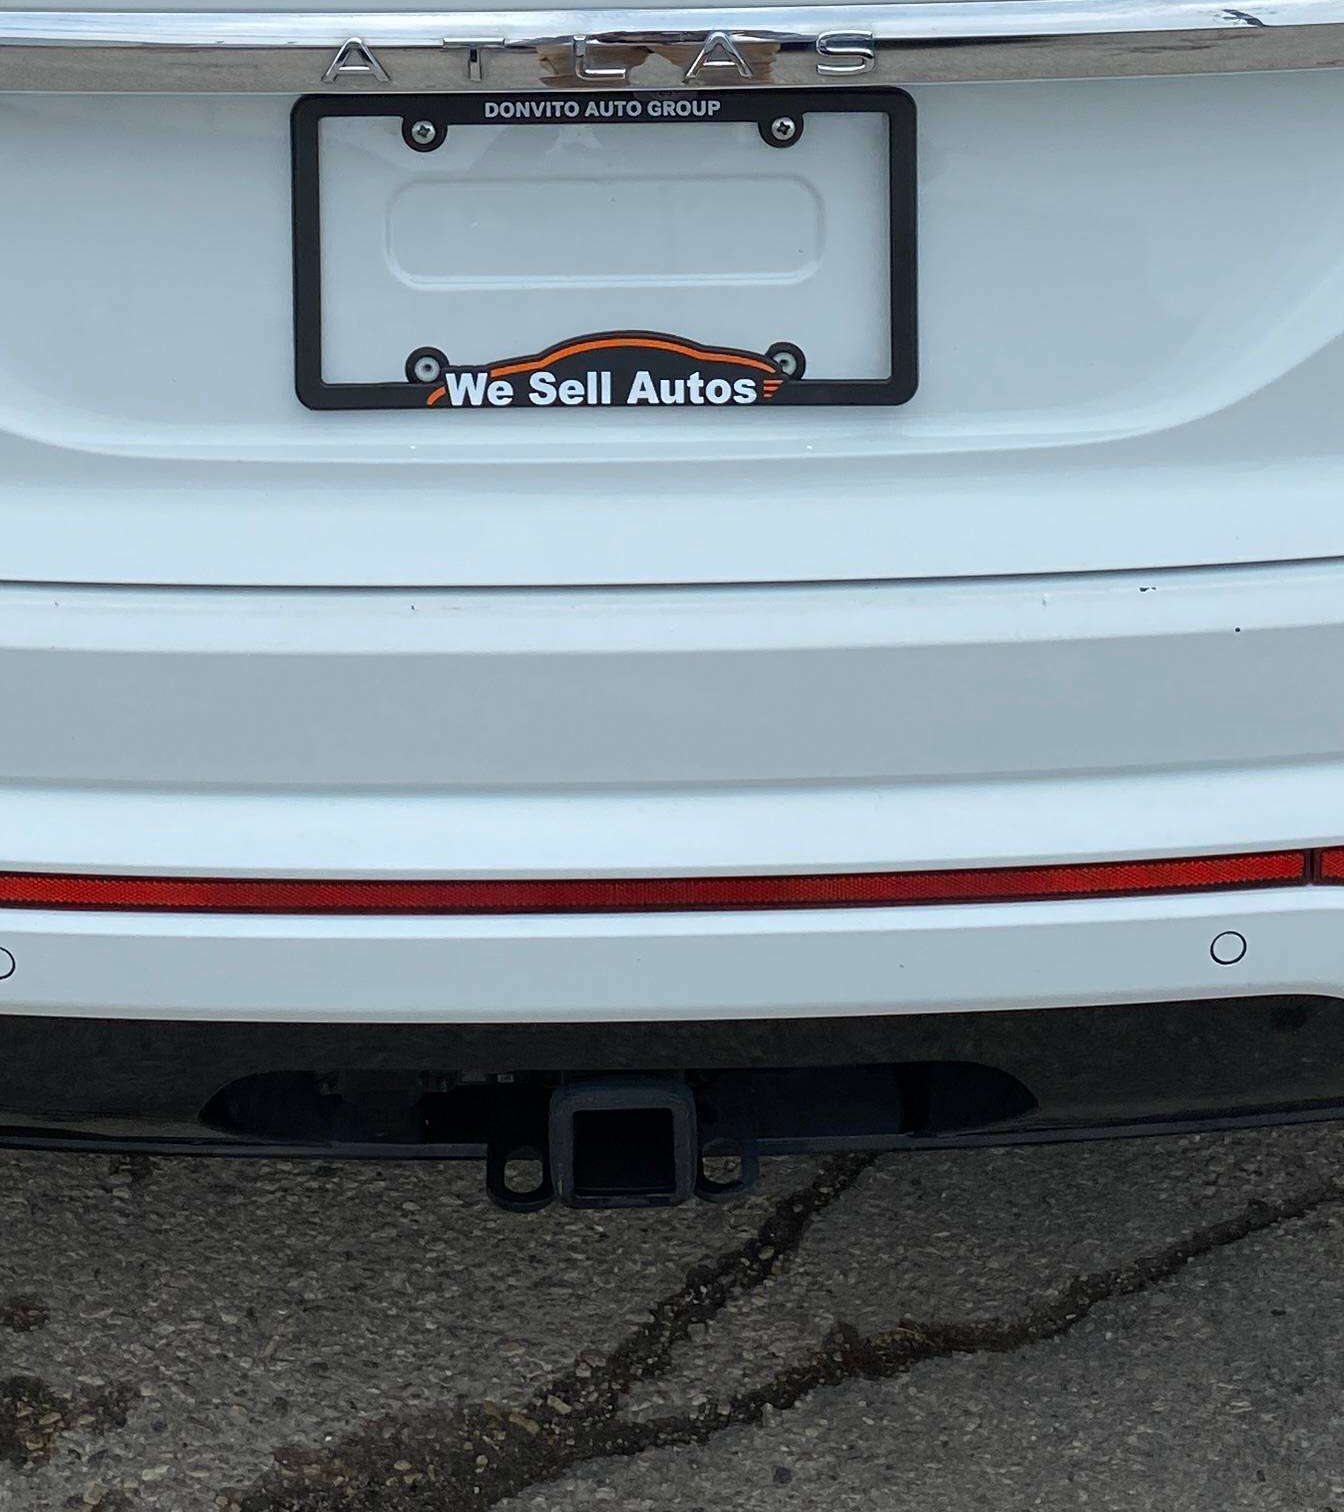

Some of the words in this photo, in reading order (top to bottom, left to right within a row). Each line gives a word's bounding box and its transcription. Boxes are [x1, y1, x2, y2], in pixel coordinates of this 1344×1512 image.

[321, 30, 876, 83] ATLAS
[485, 101, 580, 118] DONVITO
[584, 100, 642, 117] AUTO
[647, 100, 721, 117] GROUP
[445, 372, 514, 406] We
[528, 371, 611, 405] Sell
[627, 370, 757, 405] Autos
